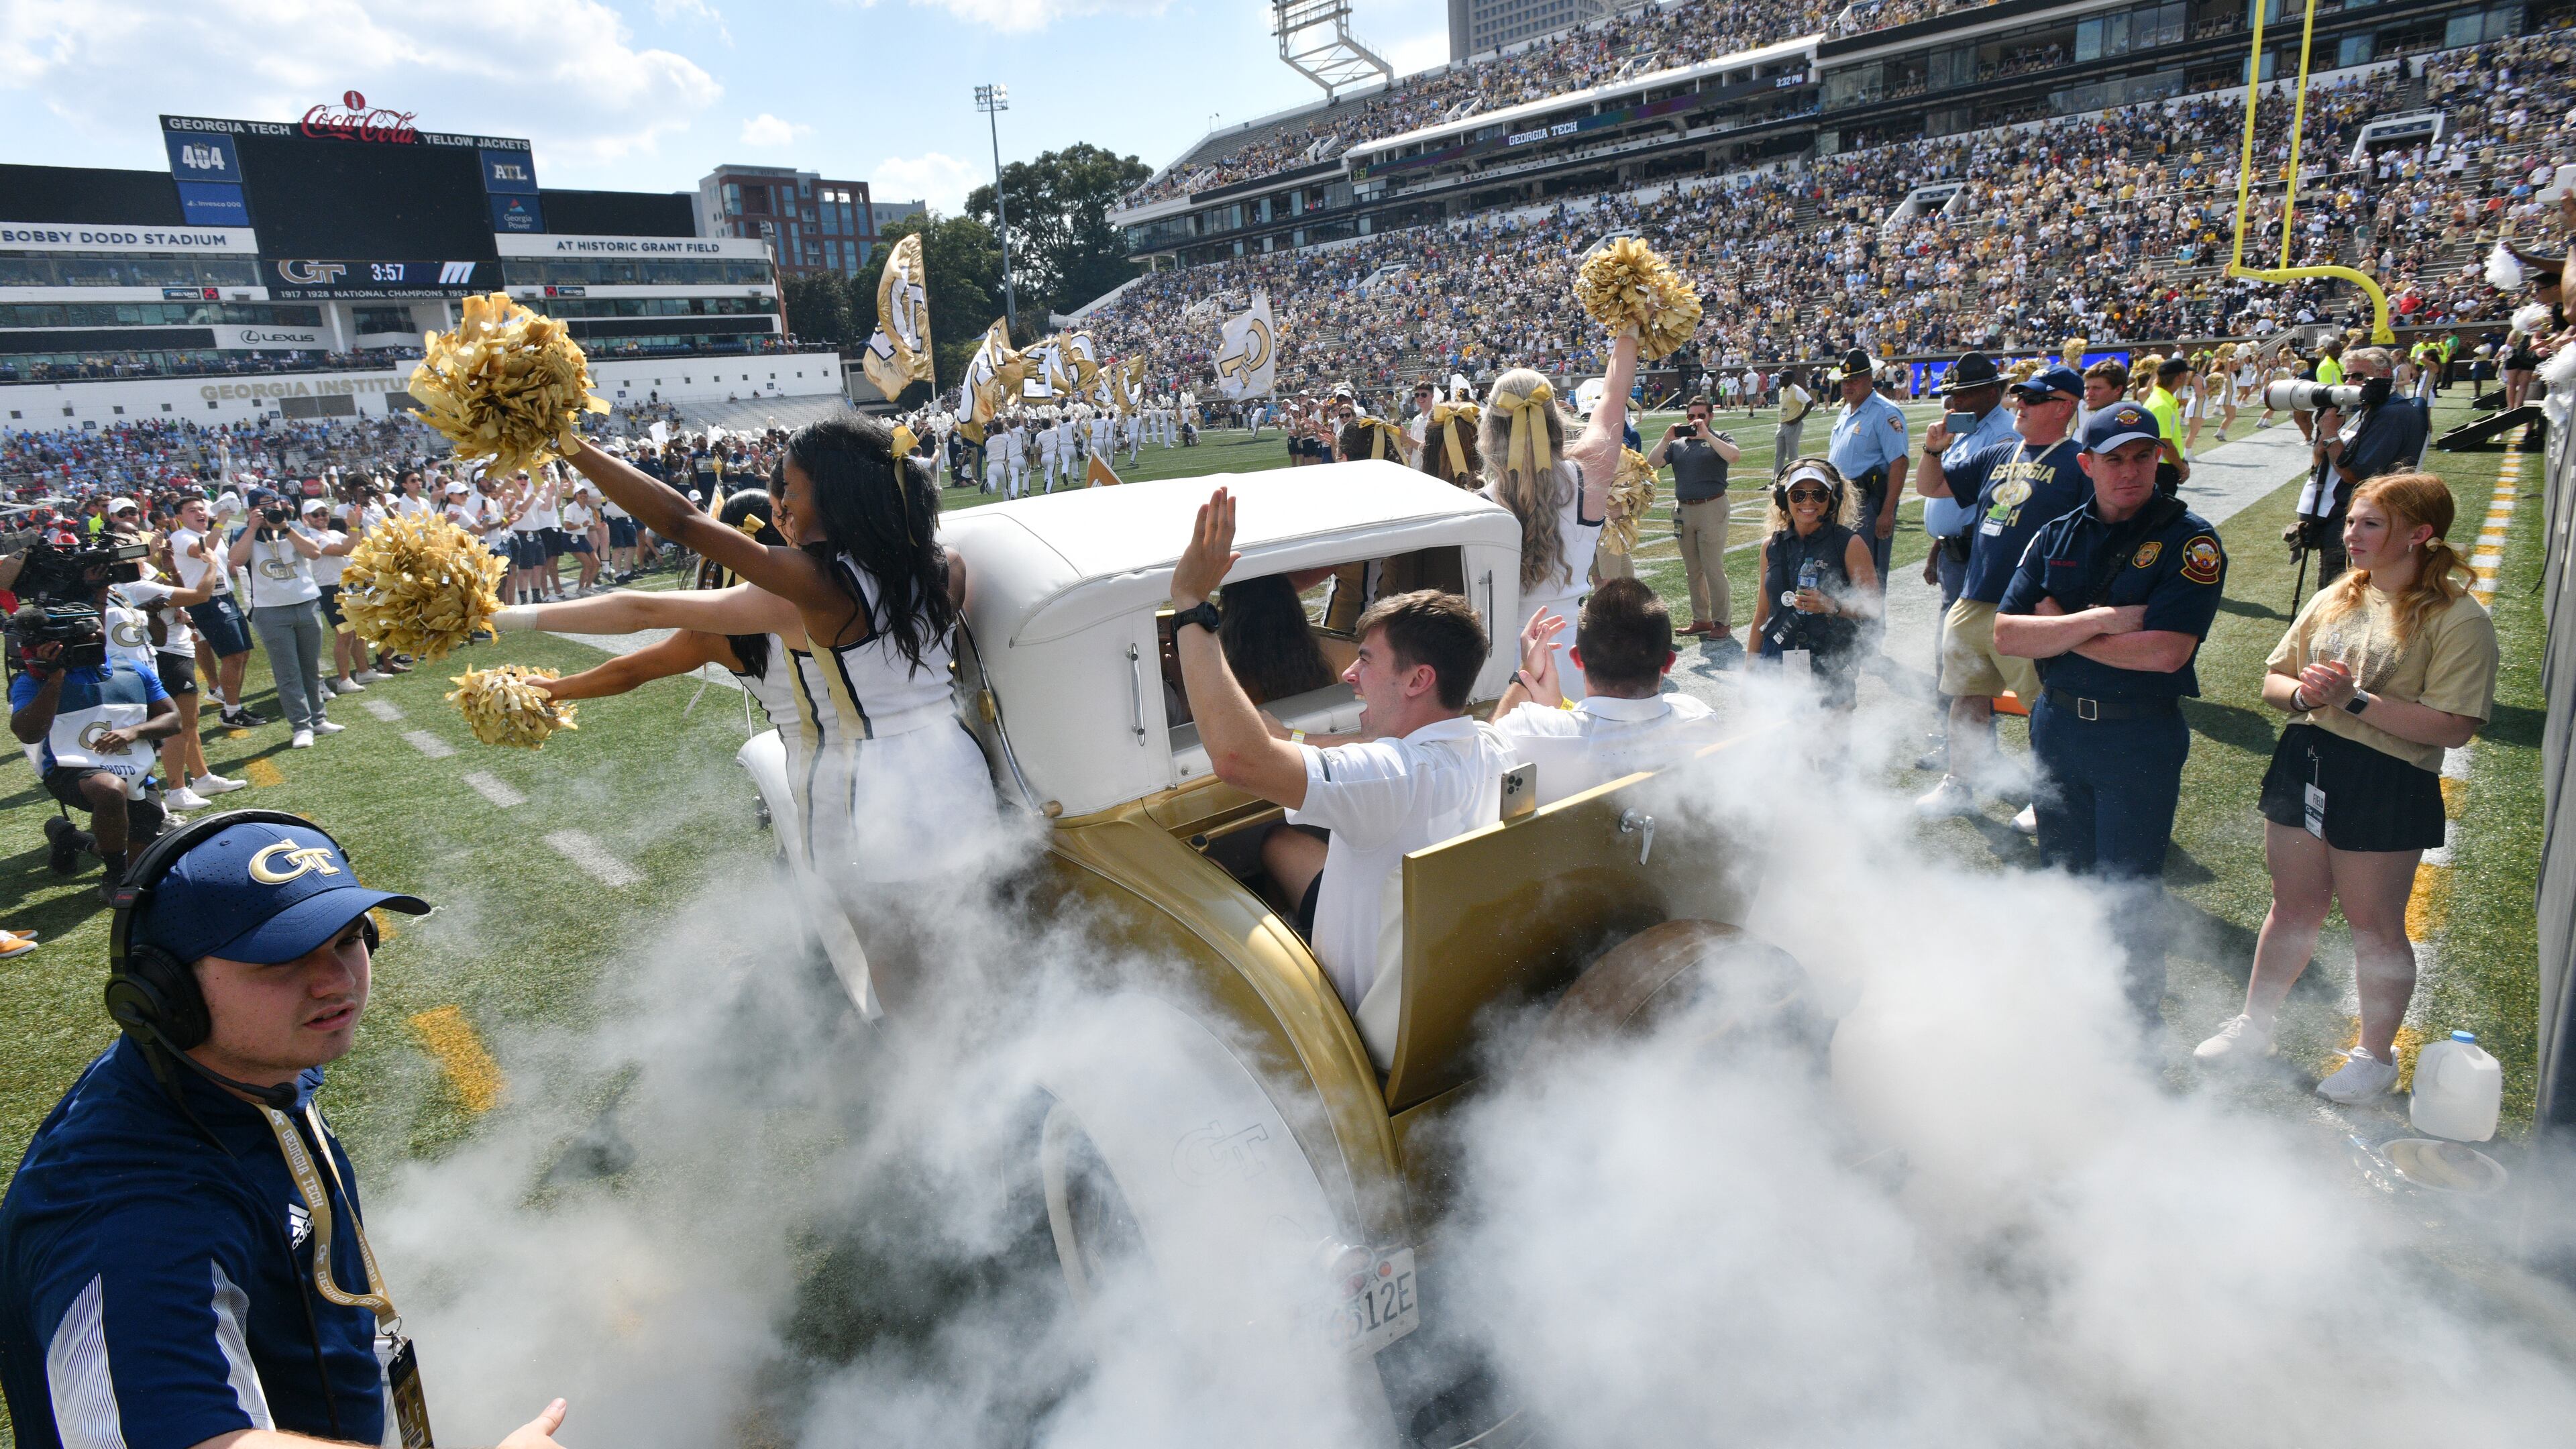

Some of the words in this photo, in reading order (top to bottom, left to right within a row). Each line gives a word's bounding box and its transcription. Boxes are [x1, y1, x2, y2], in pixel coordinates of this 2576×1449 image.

[1776, 76, 1791, 88] 3:32
[1792, 73, 1803, 85] PM
[169, 118, 246, 133] GEORGIA
[248, 123, 291, 136] TECH
[301, 104, 419, 144] Coca-Cola
[423, 134, 474, 147] YELLOW
[477, 138, 530, 150] JACKETS
[1509, 128, 1548, 147] GEORGIA
[1550, 121, 1578, 137] TECH
[182, 144, 225, 171] 404
[494, 164, 527, 180] ATL
[1353, 167, 1368, 180] 3:57
[504, 214, 533, 223] Georgia
[508, 221, 531, 229] Power
[1, 230, 72, 243] BOBBY
[80, 232, 138, 244] DODD
[145, 233, 227, 246] STADIUM
[557, 241, 573, 251] AT
[578, 241, 638, 252] HISTORIC
[642, 242, 682, 252] GRANT
[687, 243, 720, 253] FIELD
[370, 263, 405, 282] 3:57
[280, 290, 301, 299] 1917
[307, 290, 329, 298] 1928
[335, 290, 386, 298] NATIONAL
[388, 289, 444, 298] CHAMPIONS
[447, 289, 468, 297] 1952
[262, 333, 315, 342] LEXUS
[201, 380, 311, 400] GEORGIA
[2312, 793, 2324, 809] FIELD
[248, 838, 341, 885] GT
[282, 1128, 310, 1177] GEORGIA
[303, 1176, 324, 1210] TECH
[291, 1212, 315, 1251] adida
[317, 1270, 354, 1305] GEORGIA
[355, 1296, 384, 1309] TECH
